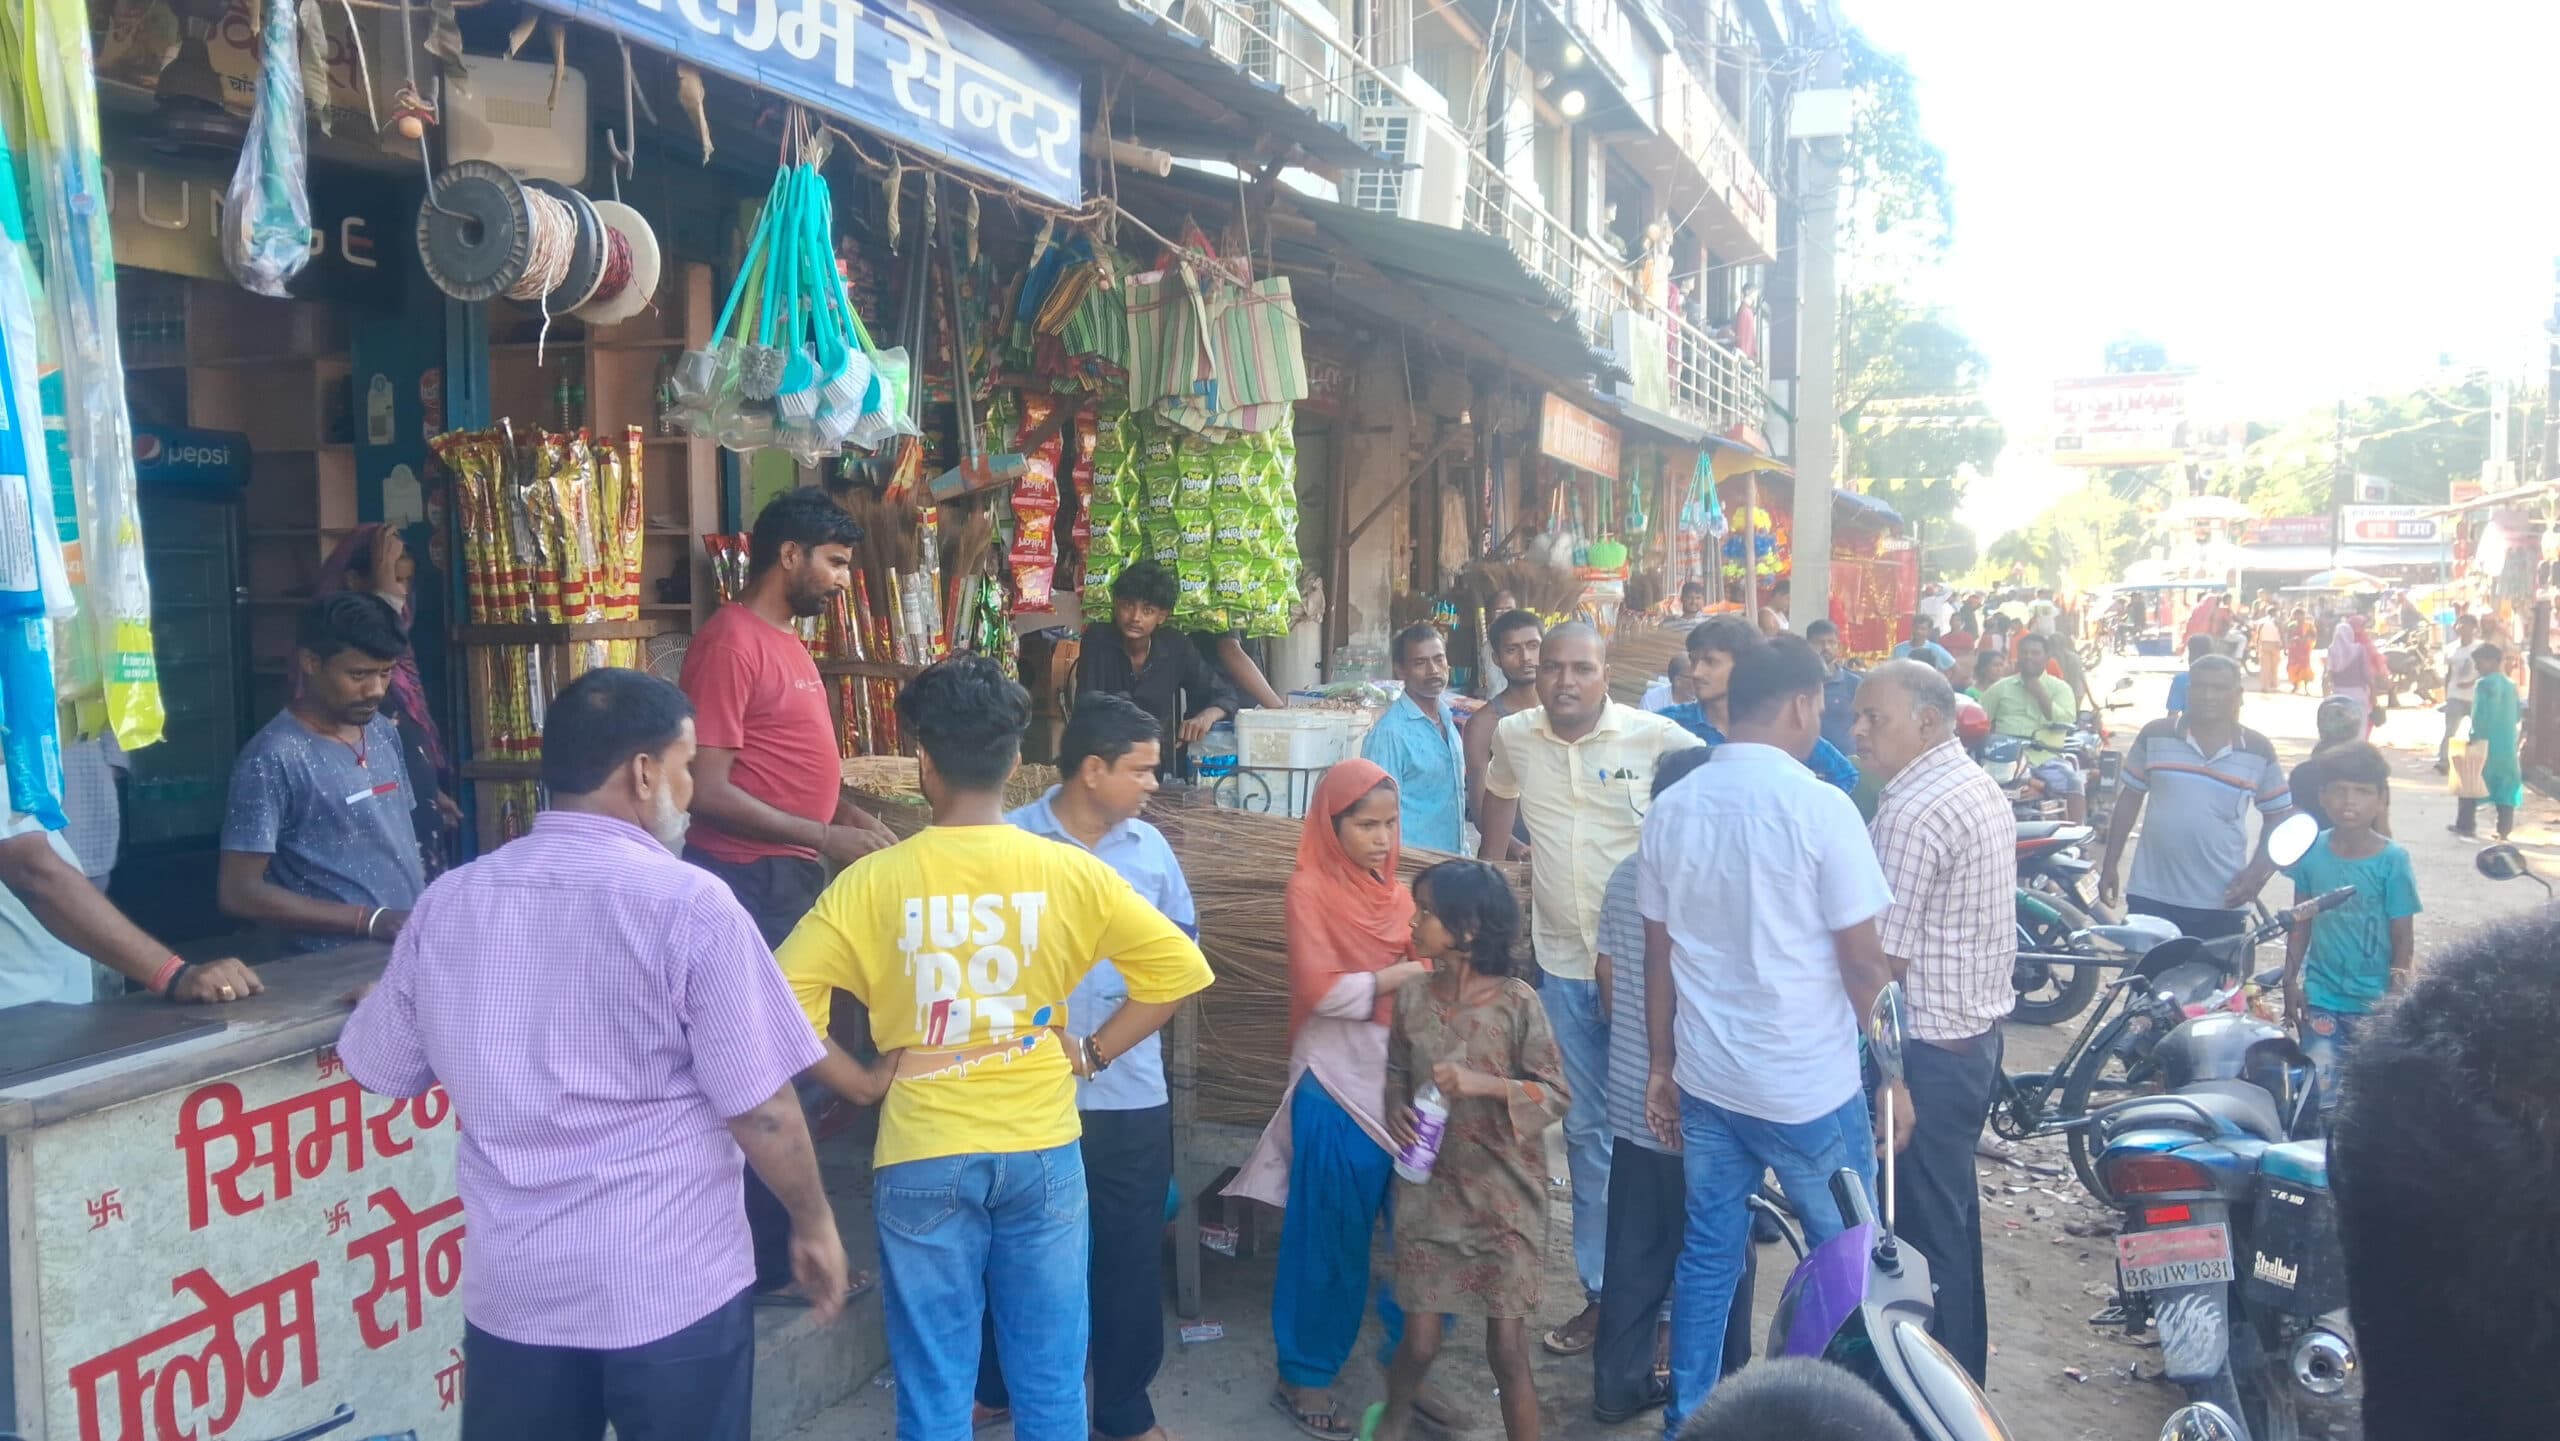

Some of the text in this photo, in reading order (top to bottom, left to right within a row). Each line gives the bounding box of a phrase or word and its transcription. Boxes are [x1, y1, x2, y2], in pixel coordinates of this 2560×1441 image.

[884, 0, 1077, 178] सेन्टर
[168, 444, 231, 469] pepsi
[898, 891, 1048, 977] JUST
[914, 944, 1019, 1032] DO
[2254, 1250, 2299, 1286] Steelbird
